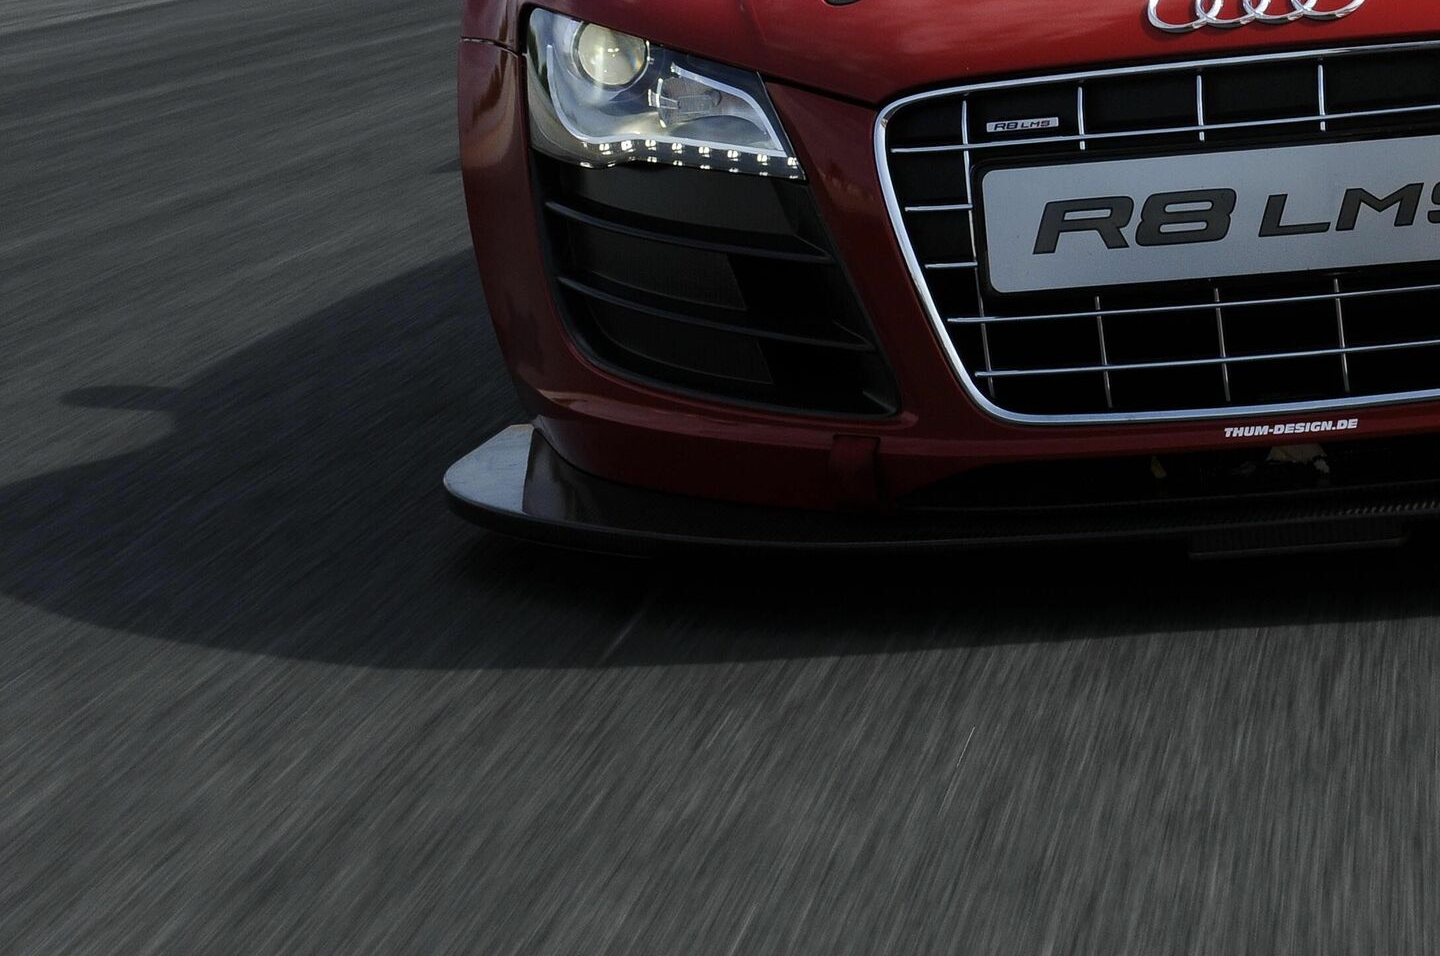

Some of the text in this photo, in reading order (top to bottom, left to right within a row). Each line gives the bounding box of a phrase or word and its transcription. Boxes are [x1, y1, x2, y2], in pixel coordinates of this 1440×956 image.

[994, 120, 1051, 131] R8 LMS
[1032, 187, 1237, 255] R8
[1224, 418, 1358, 438] THUM-DESIGN.DE
